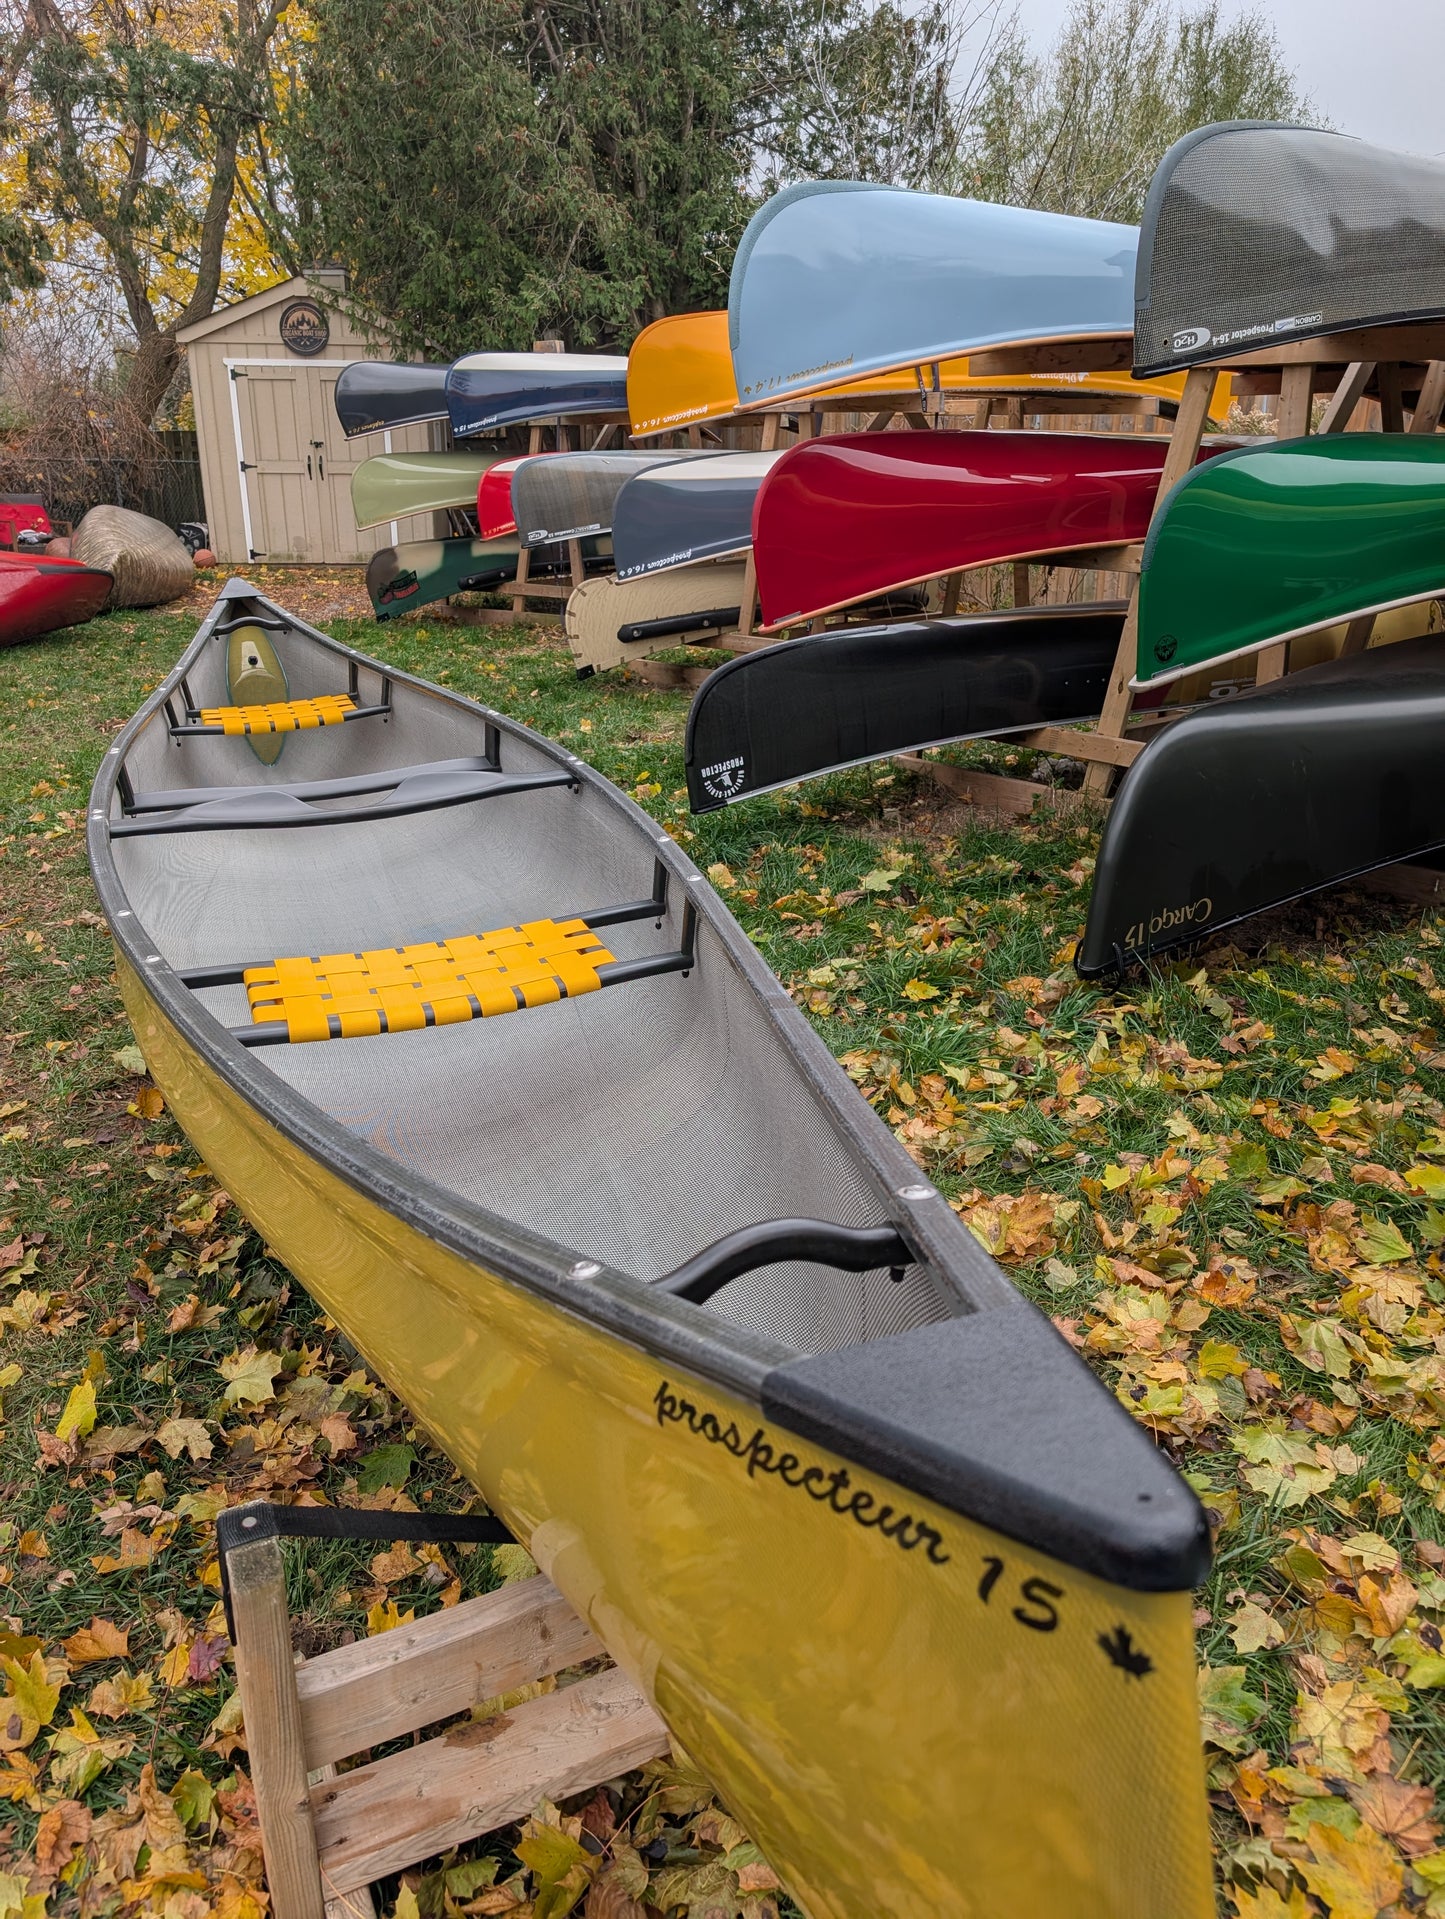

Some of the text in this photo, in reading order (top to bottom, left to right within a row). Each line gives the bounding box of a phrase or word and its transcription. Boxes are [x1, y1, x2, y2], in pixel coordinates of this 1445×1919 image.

[1231, 323, 1274, 339] Prospector
[1296, 314, 1321, 326] CARBON
[1174, 334, 1196, 348] H2O
[1212, 332, 1230, 345] 16-4
[755, 353, 854, 393] prospecteur 17.4
[642, 404, 709, 429] prospecteur 16.6
[627, 549, 692, 576] prospecteur 16.6
[701, 756, 744, 778] PROSPECTOR
[1124, 922, 1144, 951] 15
[654, 1381, 1065, 1633] prospecteur 15
